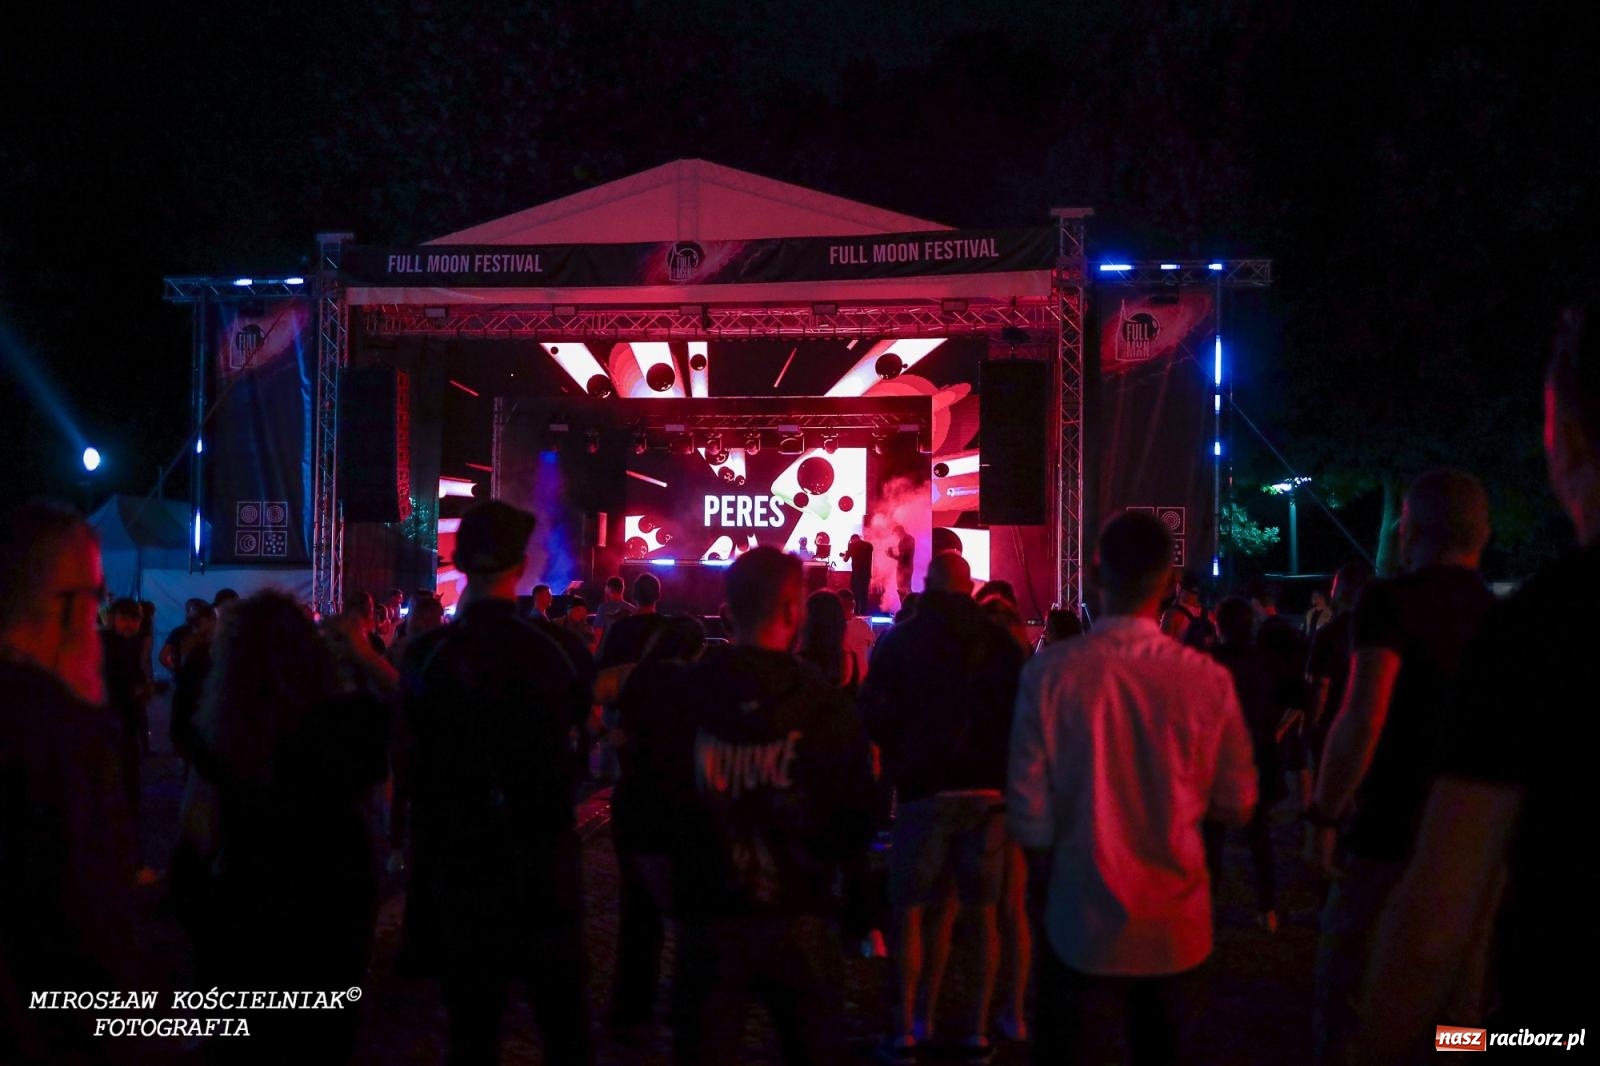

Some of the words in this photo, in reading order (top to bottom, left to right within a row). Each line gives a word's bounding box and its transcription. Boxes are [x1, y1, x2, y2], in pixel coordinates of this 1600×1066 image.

[387, 254, 423, 273] FULL
[427, 254, 470, 273] MOON
[474, 253, 543, 273] FESTIVAL
[829, 245, 868, 265] FULL
[873, 242, 919, 263] MOON
[924, 238, 999, 261] FESTIVAL
[1126, 323, 1150, 341] FULL
[704, 494, 785, 528] PERES
